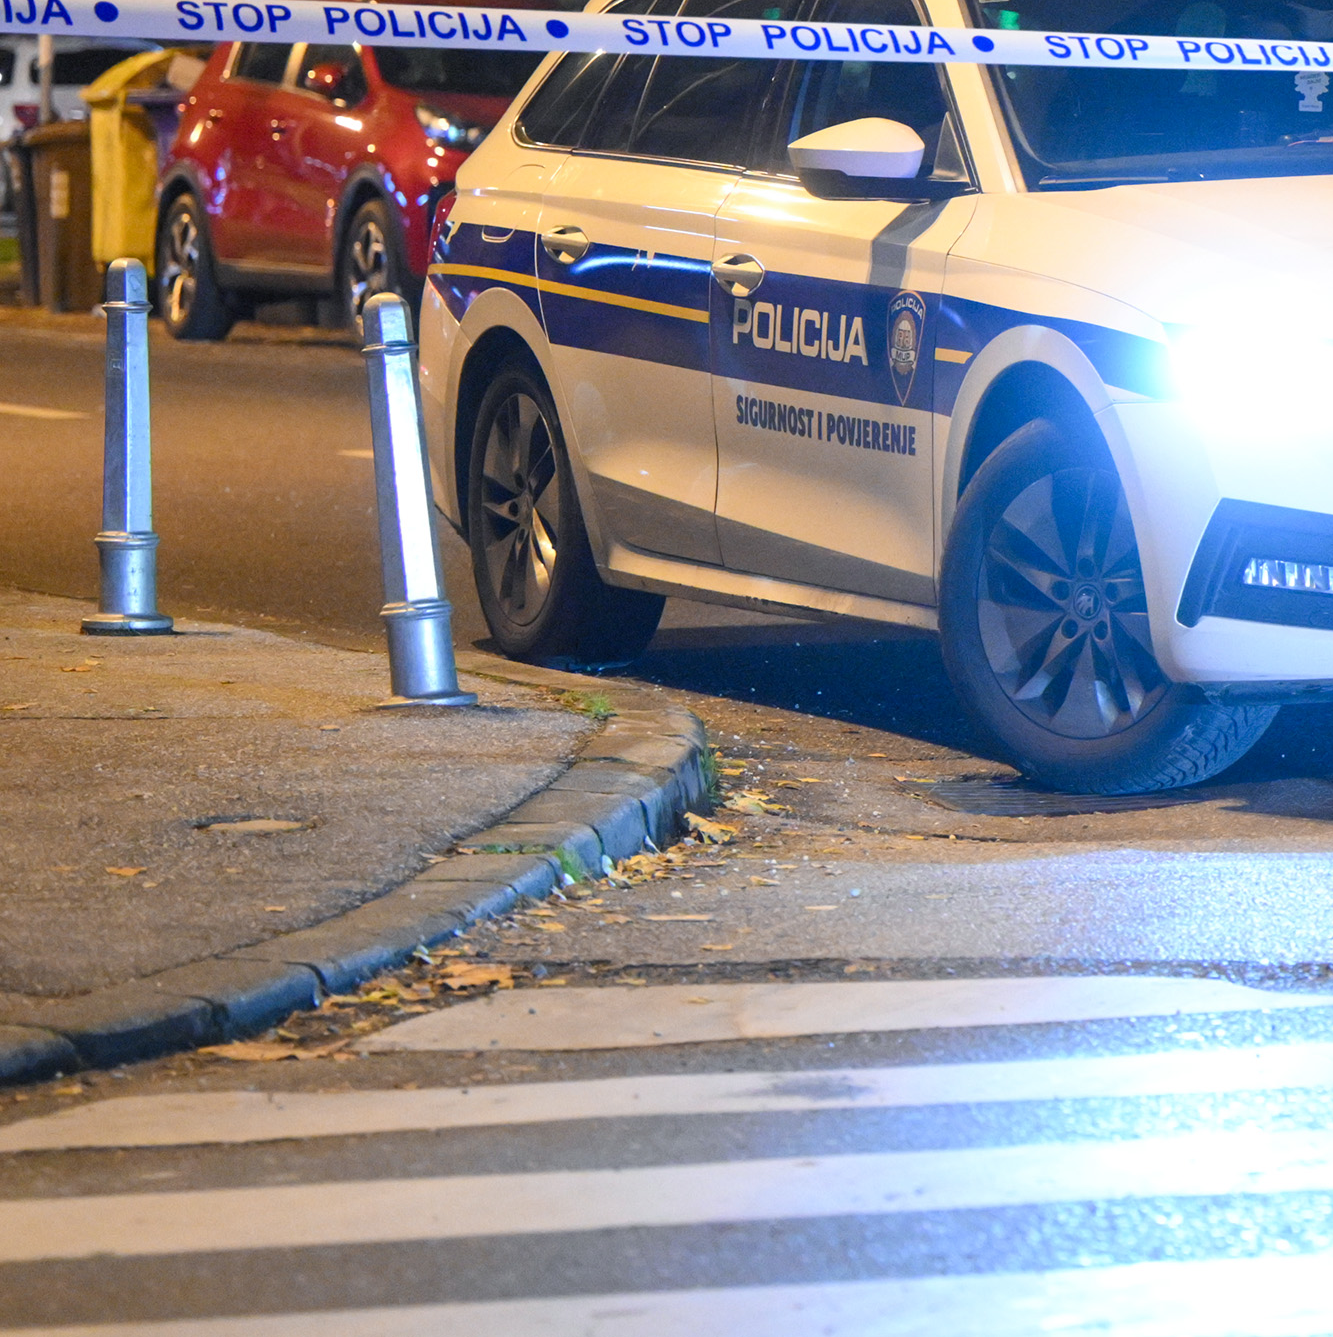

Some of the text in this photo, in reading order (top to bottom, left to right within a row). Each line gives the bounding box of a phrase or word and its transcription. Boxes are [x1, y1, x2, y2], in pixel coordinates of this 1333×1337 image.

[178, 1, 529, 43] STOP POLICIJA
[623, 18, 956, 56] STOP POLICIJA
[1046, 35, 1149, 61] STOP
[891, 297, 923, 320] POLICIJA
[732, 300, 869, 366] POLICIJA
[896, 350, 911, 361] MUP
[736, 394, 916, 456] SIGURNOST I POVJERENJE
